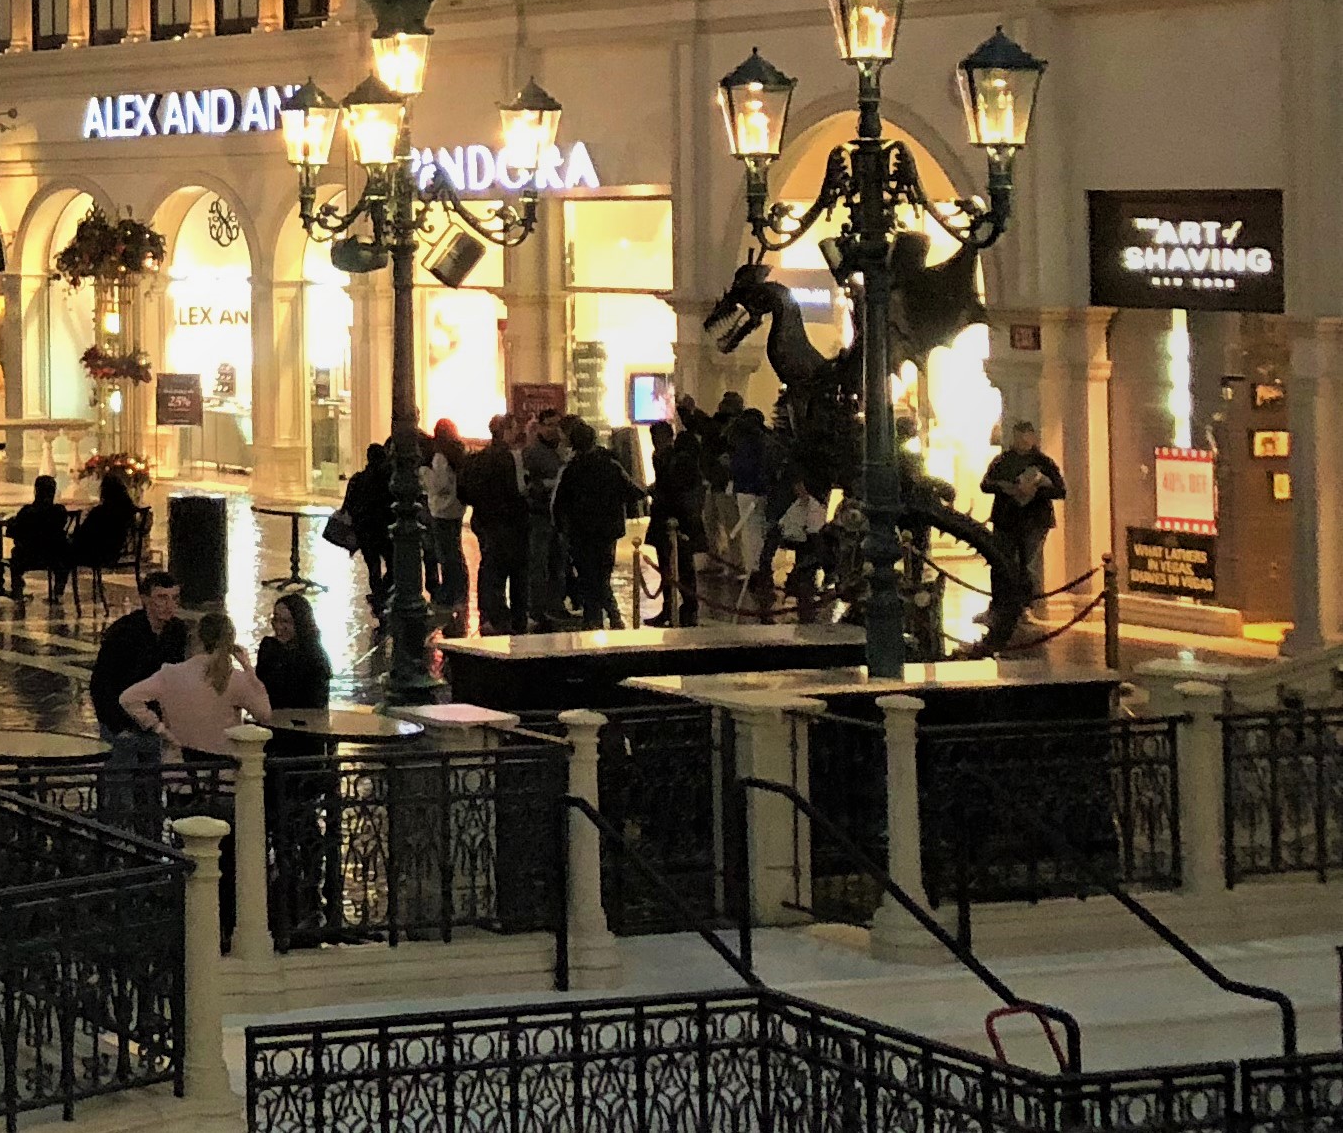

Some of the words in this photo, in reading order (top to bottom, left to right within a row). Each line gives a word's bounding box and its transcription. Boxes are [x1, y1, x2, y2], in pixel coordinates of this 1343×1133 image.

[83, 94, 158, 138] ALEX
[164, 89, 235, 135] AND
[242, 85, 302, 131] AN
[1156, 221, 1221, 245] ART
[1124, 247, 1271, 273] SHAVING
[174, 307, 212, 325] LEX
[219, 310, 249, 325] AN
